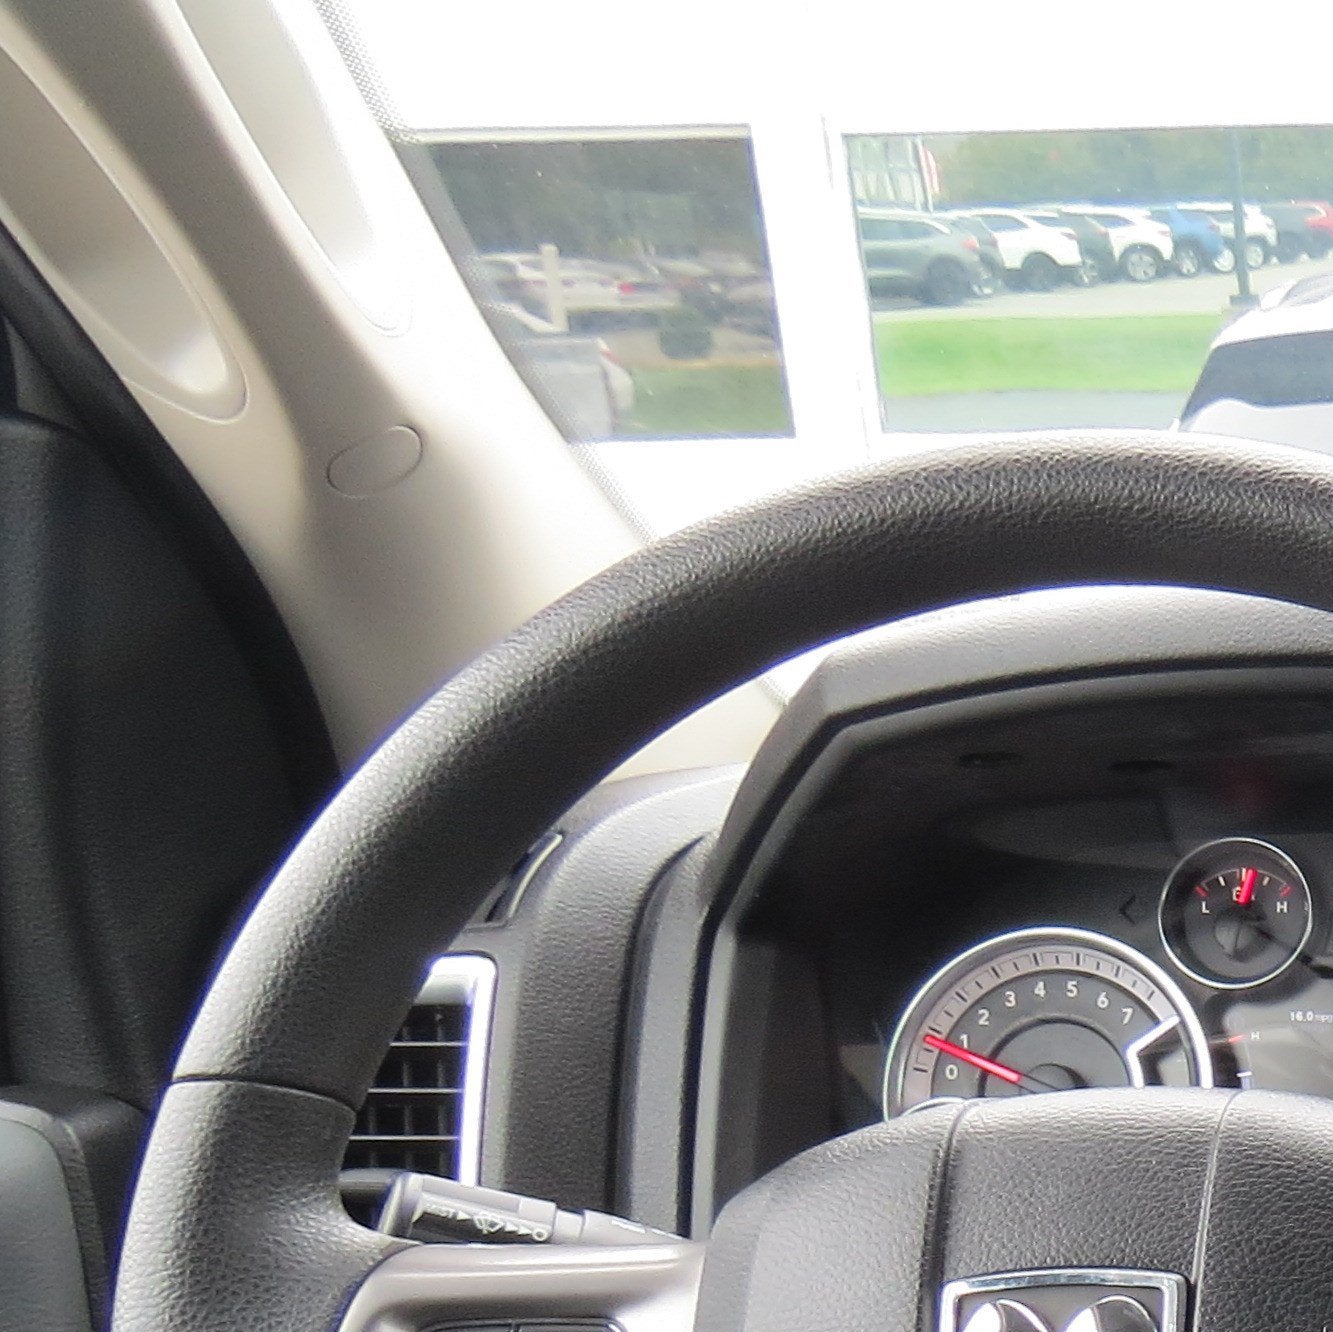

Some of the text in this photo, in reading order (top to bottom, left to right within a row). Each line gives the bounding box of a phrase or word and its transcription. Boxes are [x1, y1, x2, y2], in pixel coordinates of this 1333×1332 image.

[1203, 902, 1209, 913] L
[1277, 902, 1287, 912] H
[1034, 982, 1046, 998] 4
[1066, 981, 1078, 997] 5
[1004, 992, 1016, 1007] 3
[1098, 993, 1109, 1009] 6
[978, 1009, 989, 1026] 2
[1122, 1008, 1133, 1024] 7
[961, 1034, 969, 1048] 1
[946, 1065, 958, 1080] 0
